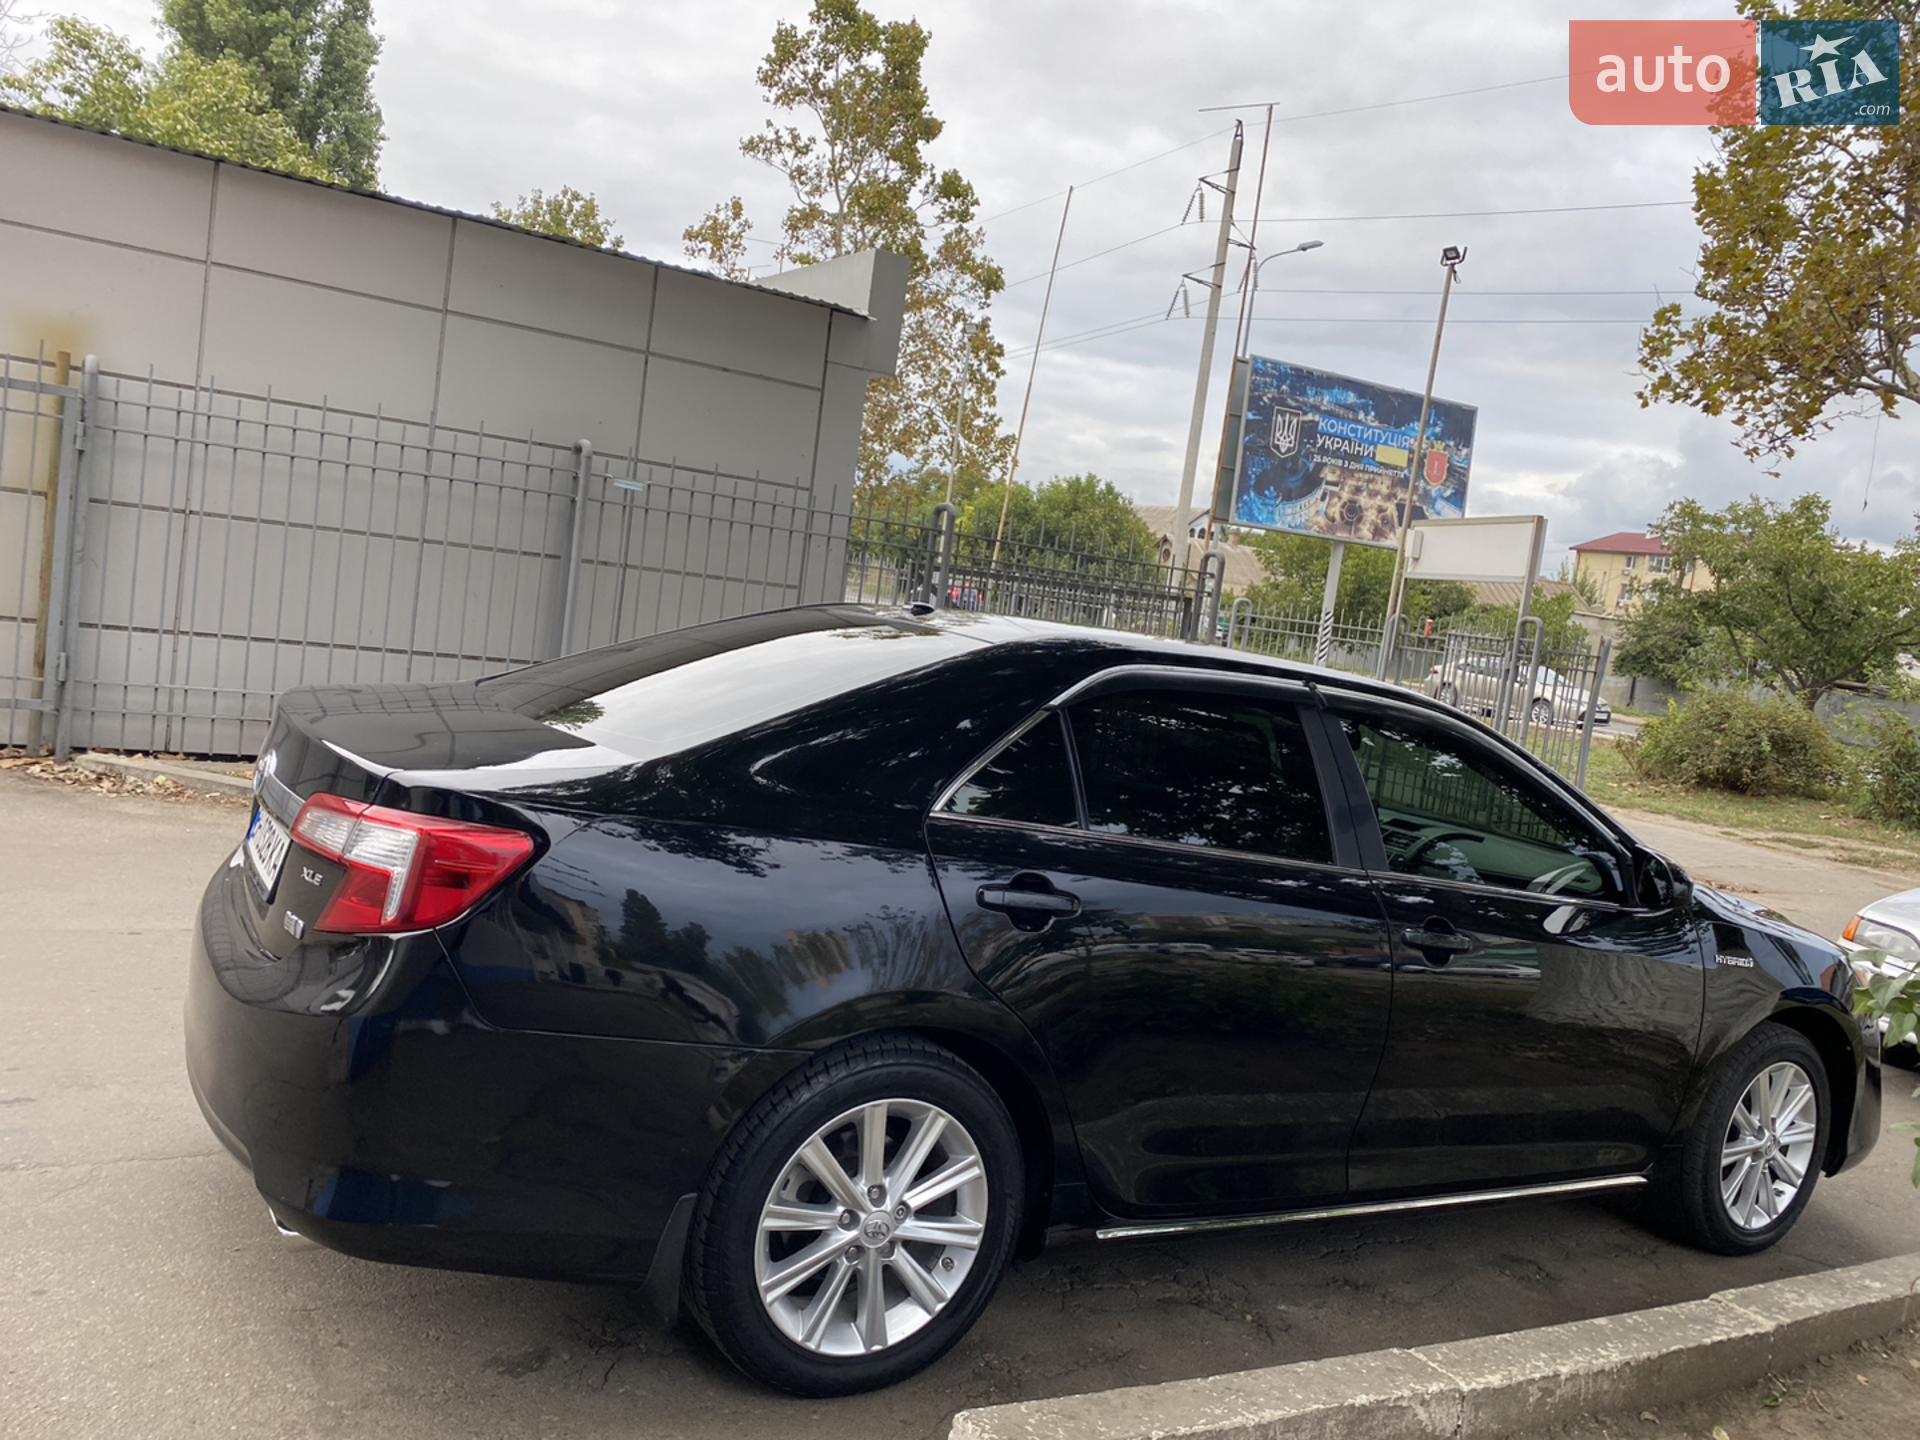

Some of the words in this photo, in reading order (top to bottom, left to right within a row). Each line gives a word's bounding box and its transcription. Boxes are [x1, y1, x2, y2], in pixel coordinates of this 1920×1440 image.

[1318, 418, 1409, 448] КОНСТИТУЦІЯ
[1316, 434, 1374, 457] УКРАЇНИ
[301, 867, 324, 886] XLE
